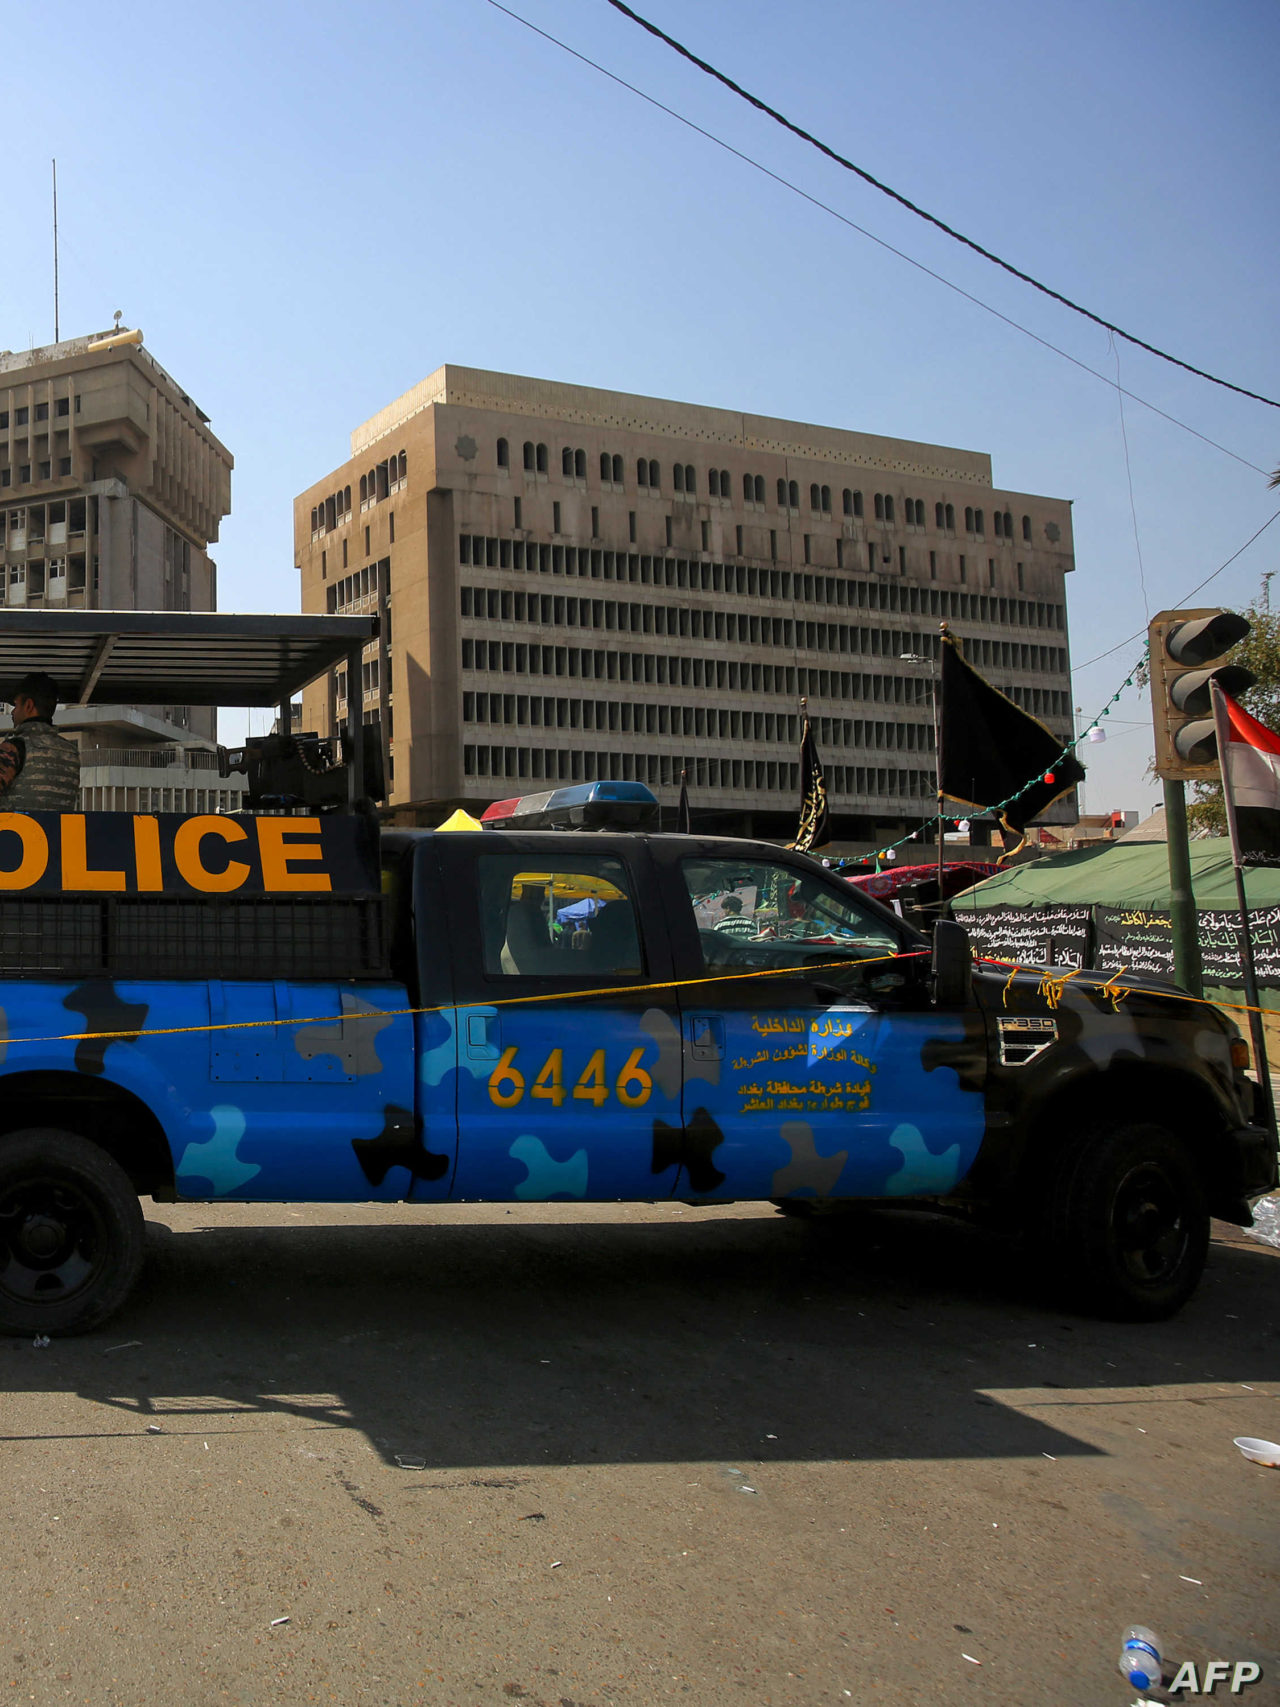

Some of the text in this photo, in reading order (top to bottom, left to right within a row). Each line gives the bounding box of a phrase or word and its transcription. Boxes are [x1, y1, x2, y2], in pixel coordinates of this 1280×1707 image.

[752, 1015, 853, 1037] وزارة الداخلية
[732, 1049, 770, 1070] الشرطة
[811, 1044, 847, 1061] الوزارة
[850, 1050, 878, 1074] وكالة
[488, 1047, 652, 1109] 6446
[737, 1080, 871, 1096] قيادة شرطة محافظة بغداد
[739, 1098, 775, 1113] العاشر
[777, 1098, 804, 1111] بغداد
[846, 1096, 870, 1111] فوج
